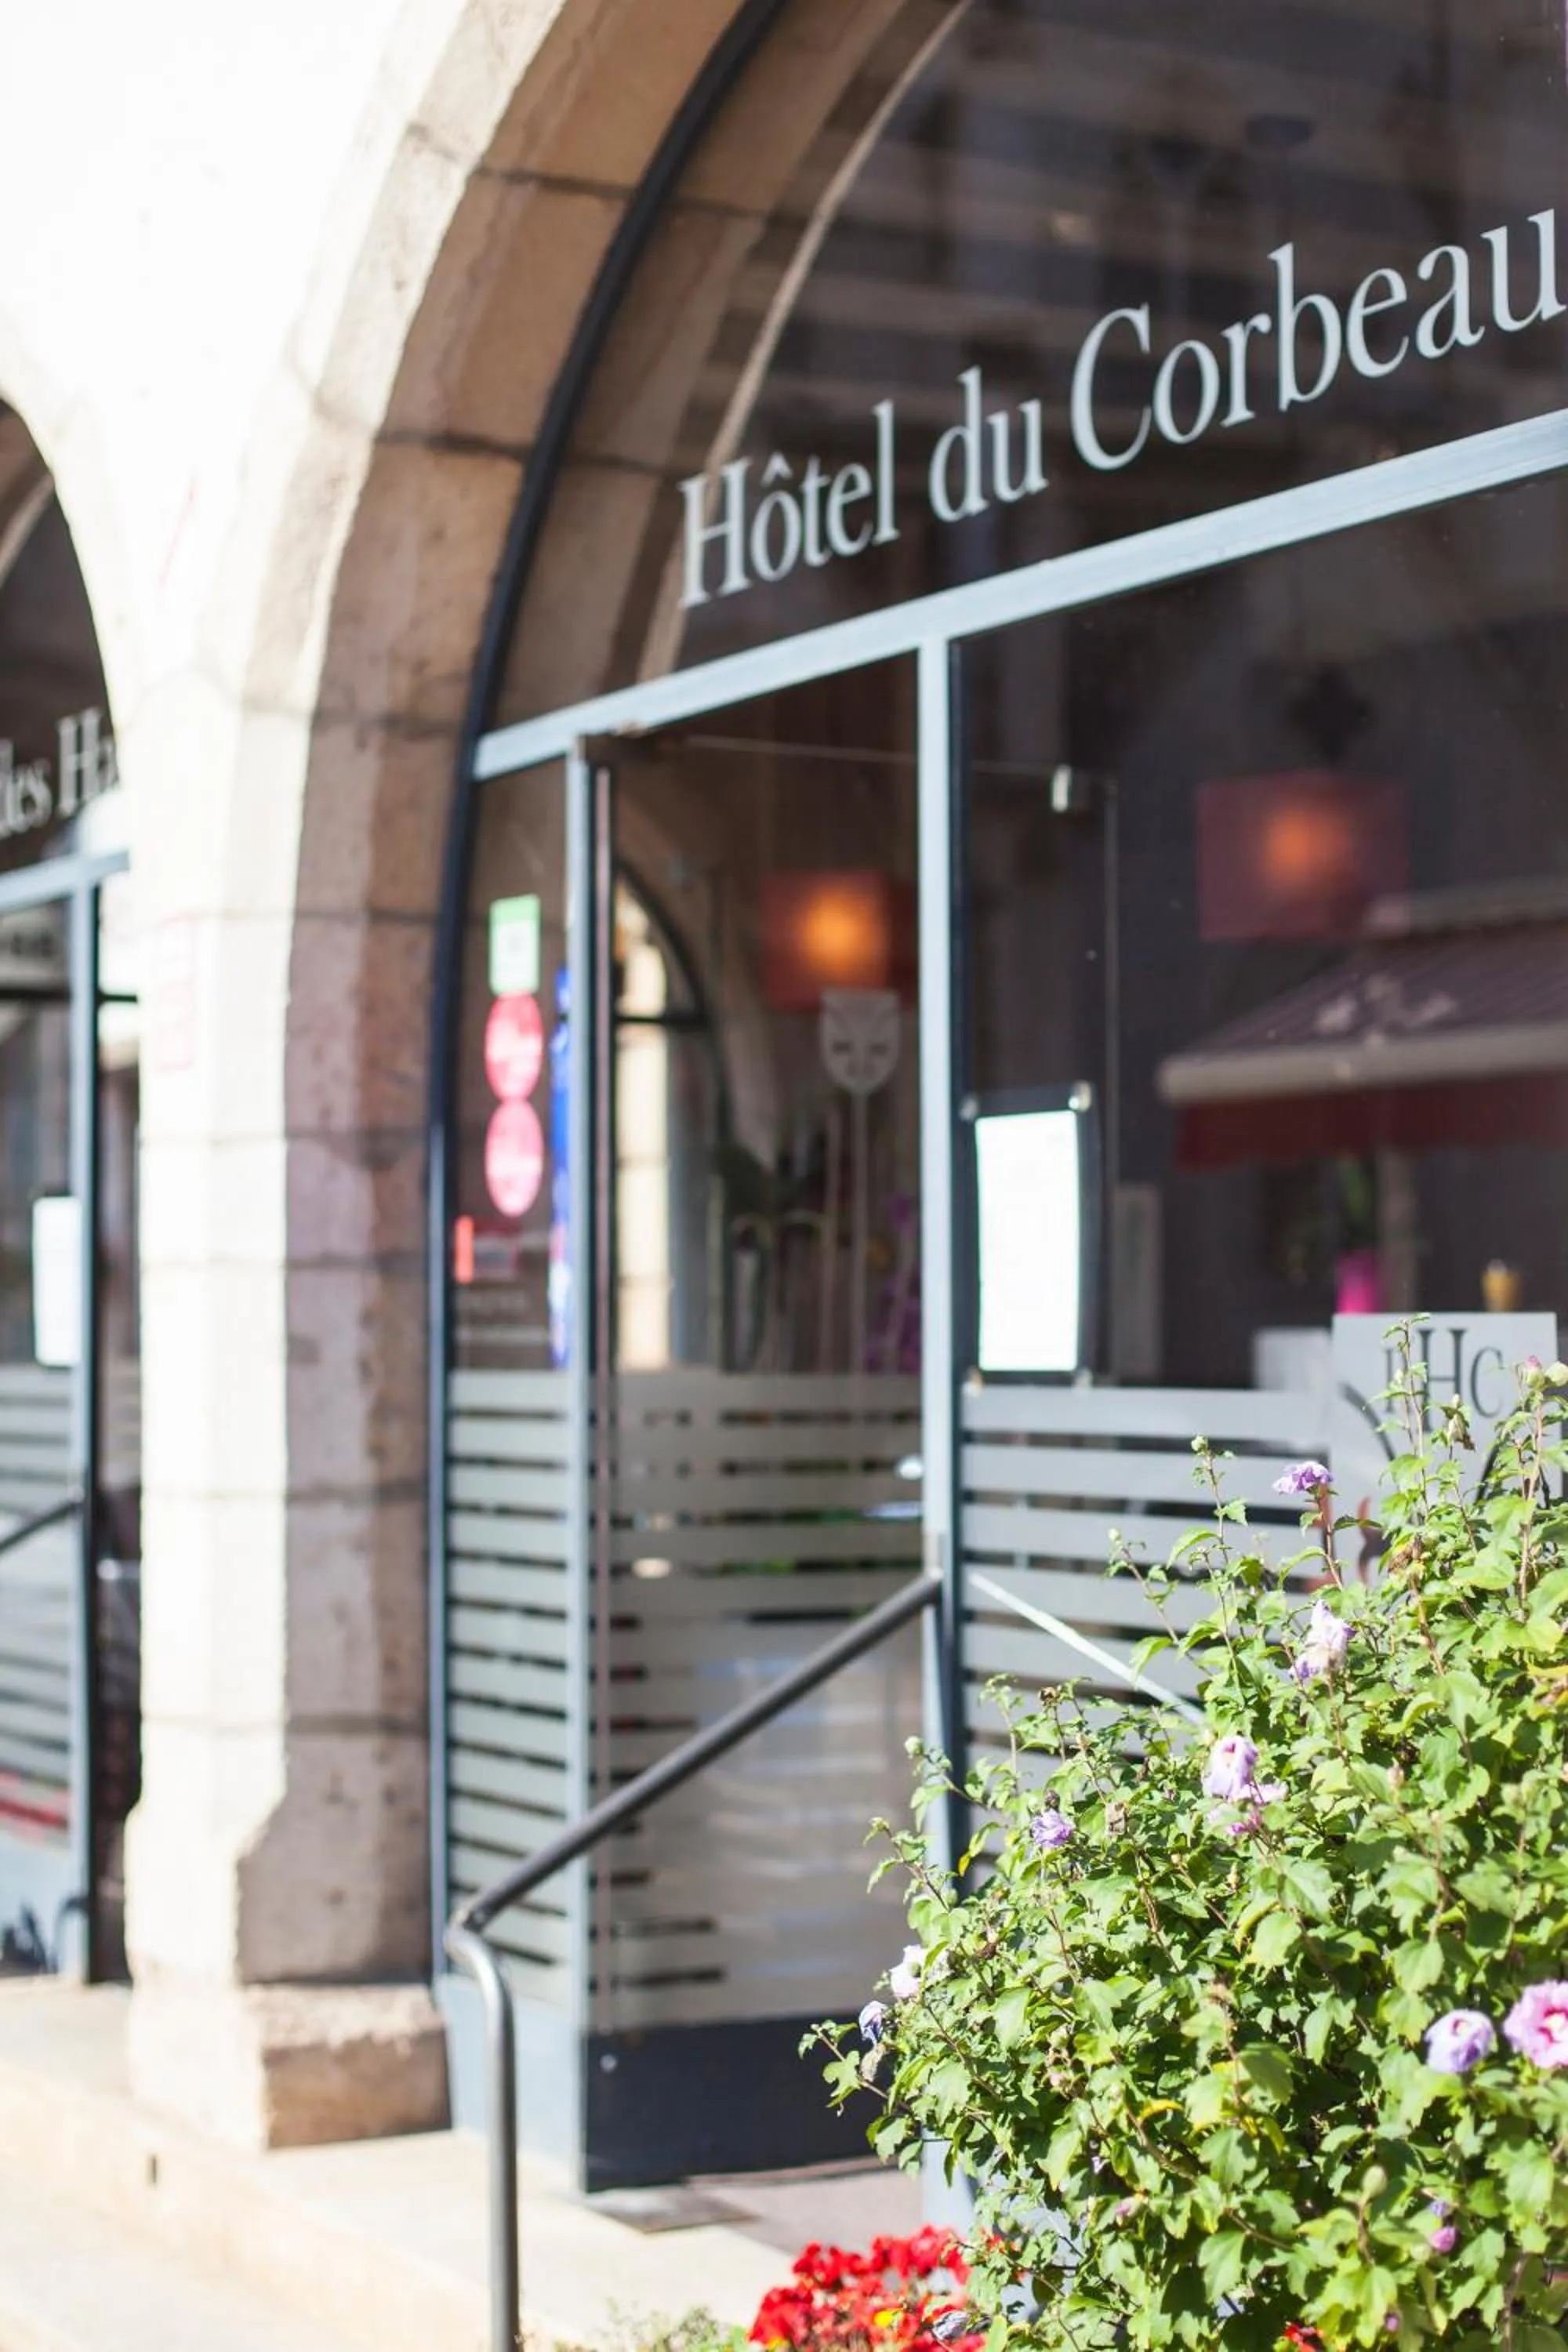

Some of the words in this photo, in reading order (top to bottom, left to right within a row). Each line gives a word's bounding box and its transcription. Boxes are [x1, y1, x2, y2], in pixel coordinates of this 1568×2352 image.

[678, 398, 901, 609] Hôtel
[929, 365, 1049, 523] du
[1070, 208, 1568, 470] Corbeau
